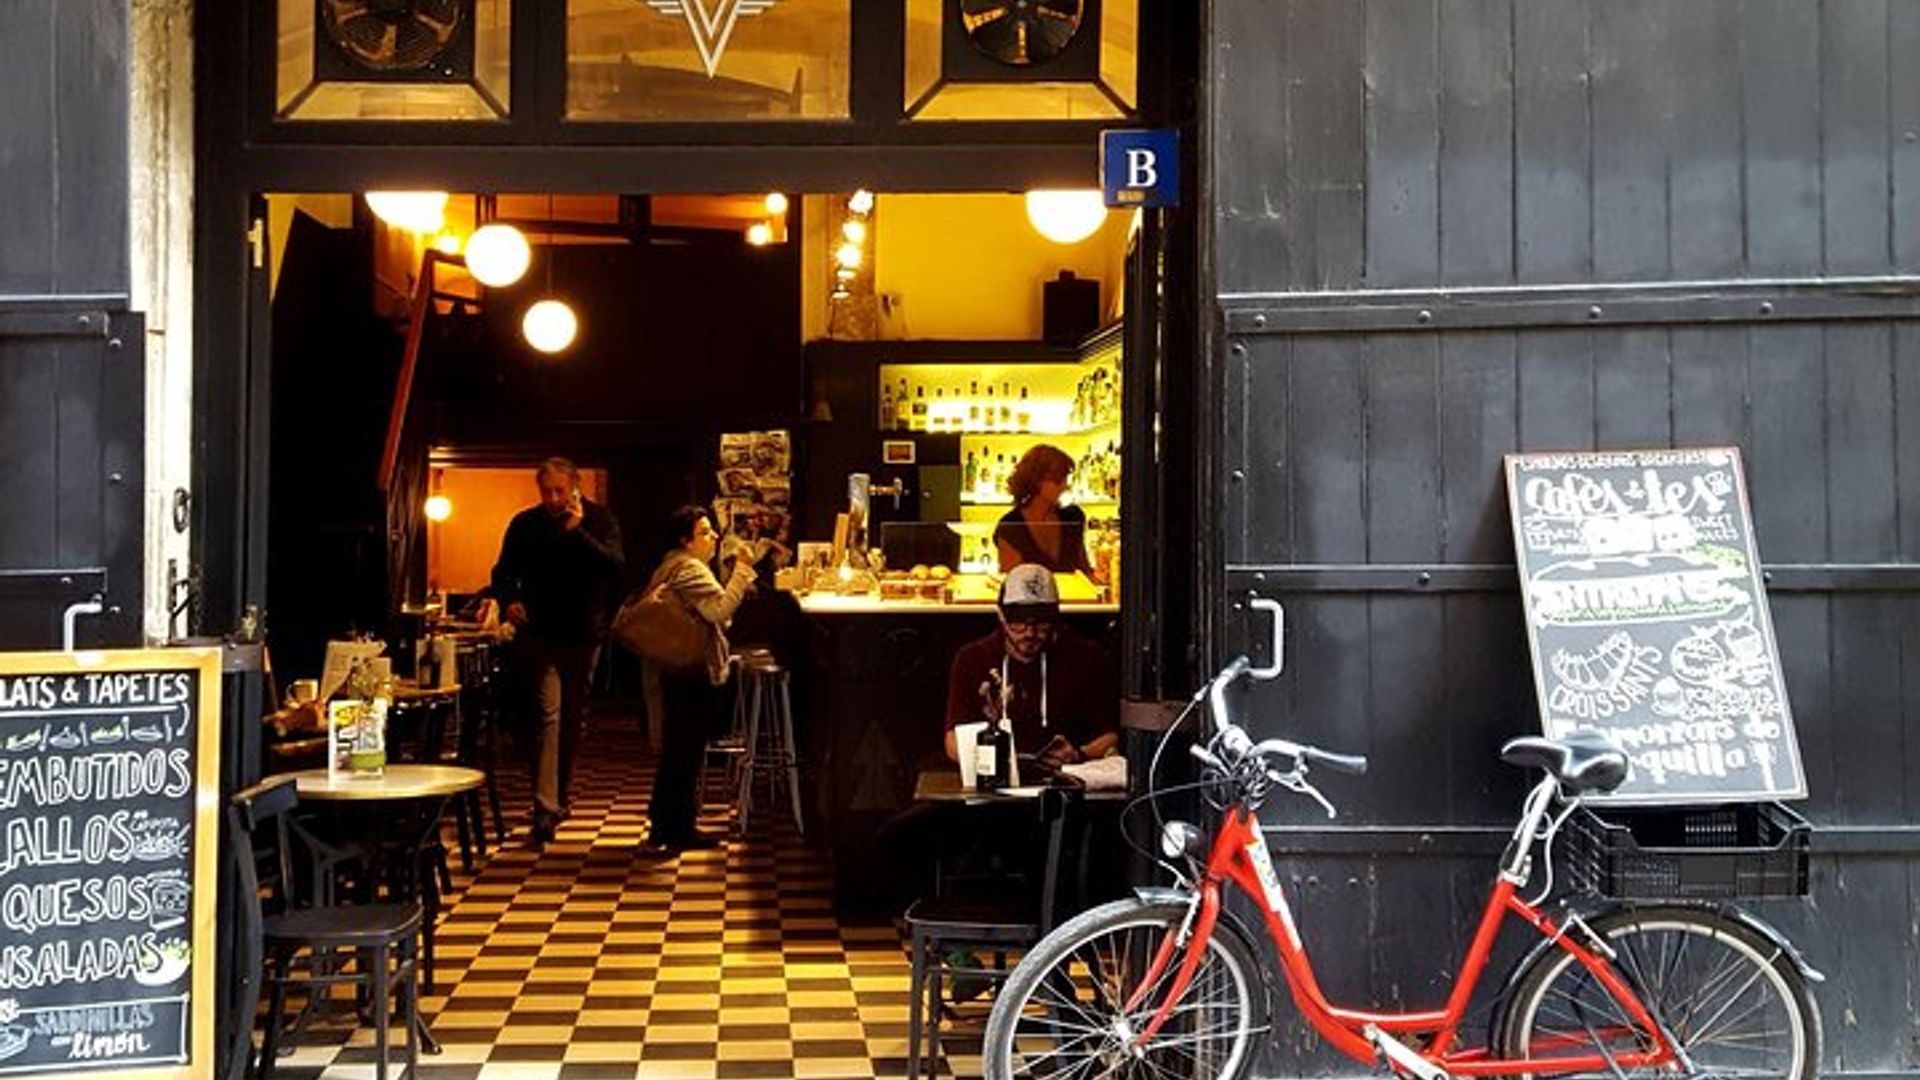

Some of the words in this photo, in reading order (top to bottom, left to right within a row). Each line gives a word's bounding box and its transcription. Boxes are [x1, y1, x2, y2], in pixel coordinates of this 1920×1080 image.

[1126, 148, 1157, 188] B
[61, 677, 80, 703] &
[85, 672, 191, 705] TAPETES
[0, 809, 135, 874] ALLOS
[3, 875, 151, 934] QUESOS
